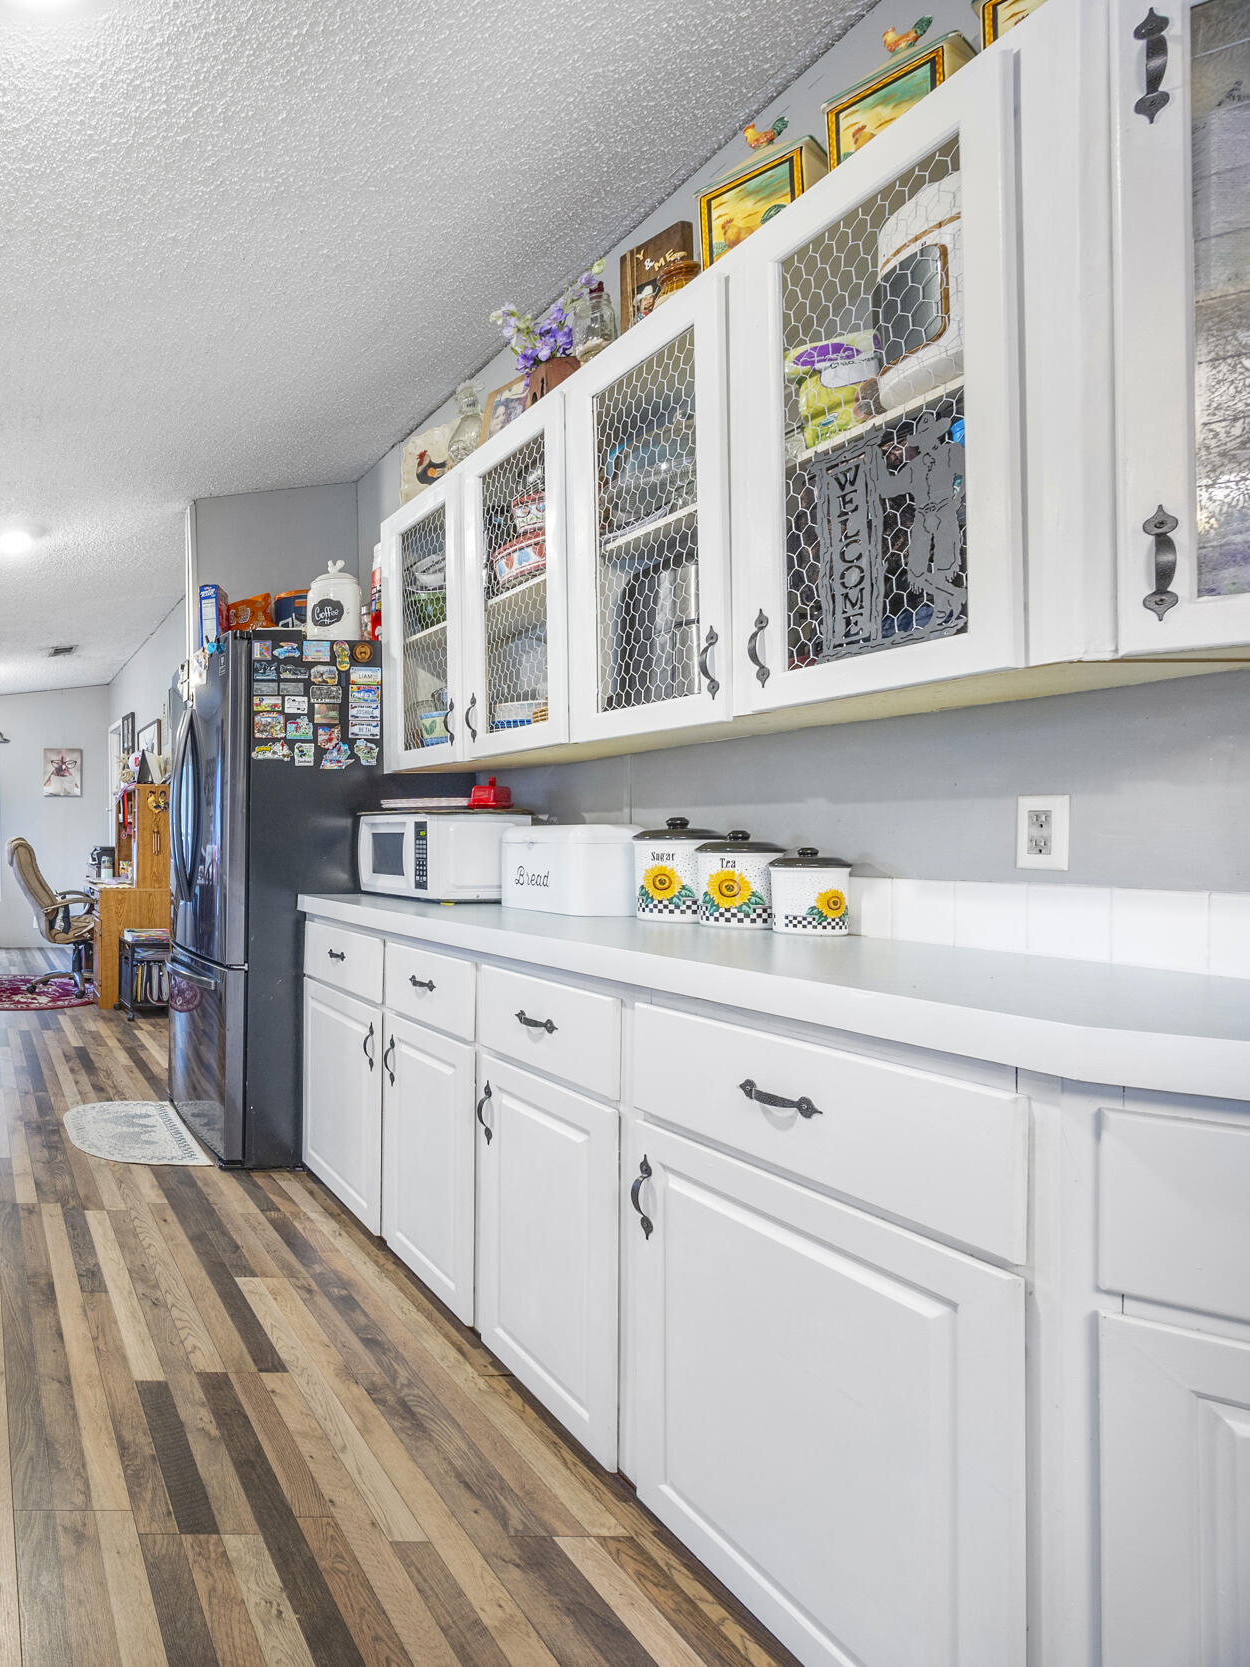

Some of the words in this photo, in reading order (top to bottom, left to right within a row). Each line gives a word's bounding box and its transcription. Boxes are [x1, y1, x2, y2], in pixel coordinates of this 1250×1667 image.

[832, 463, 867, 640] WELCOME
[314, 606, 339, 622] Coffee
[651, 851, 676, 862] Sugar
[720, 857, 737, 869] Tea
[514, 865, 550, 888] Bread
